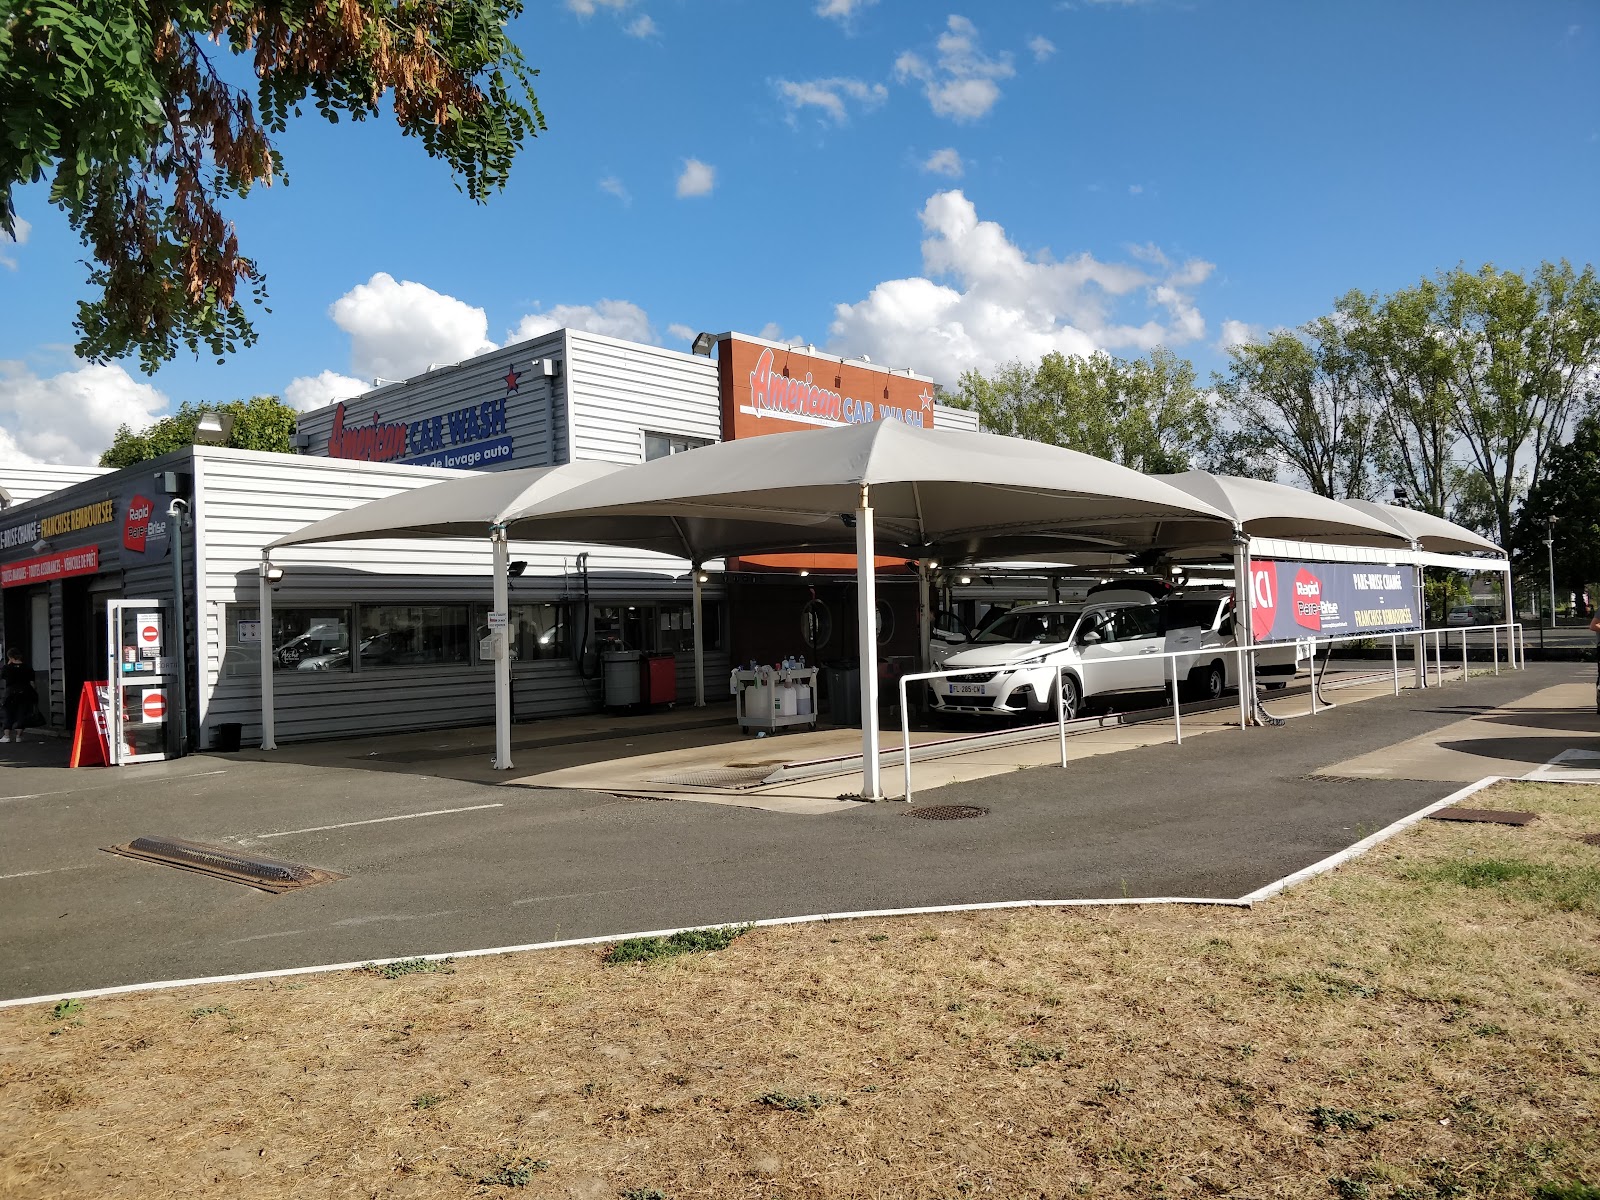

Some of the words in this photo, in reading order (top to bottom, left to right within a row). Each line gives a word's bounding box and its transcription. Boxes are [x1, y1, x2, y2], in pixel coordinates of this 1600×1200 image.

[750, 348, 840, 419] American
[843, 397, 874, 423] CAR
[879, 403, 923, 428] WASH
[328, 401, 407, 461] American
[409, 416, 445, 455] CAR
[448, 398, 507, 445] WASH
[430, 458, 443, 468] de
[445, 453, 481, 466] lavage
[483, 445, 510, 460] auto
[41, 511, 70, 538] FRANCHISE
[129, 504, 149, 521] Rapid
[1296, 581, 1320, 598] Rapid
